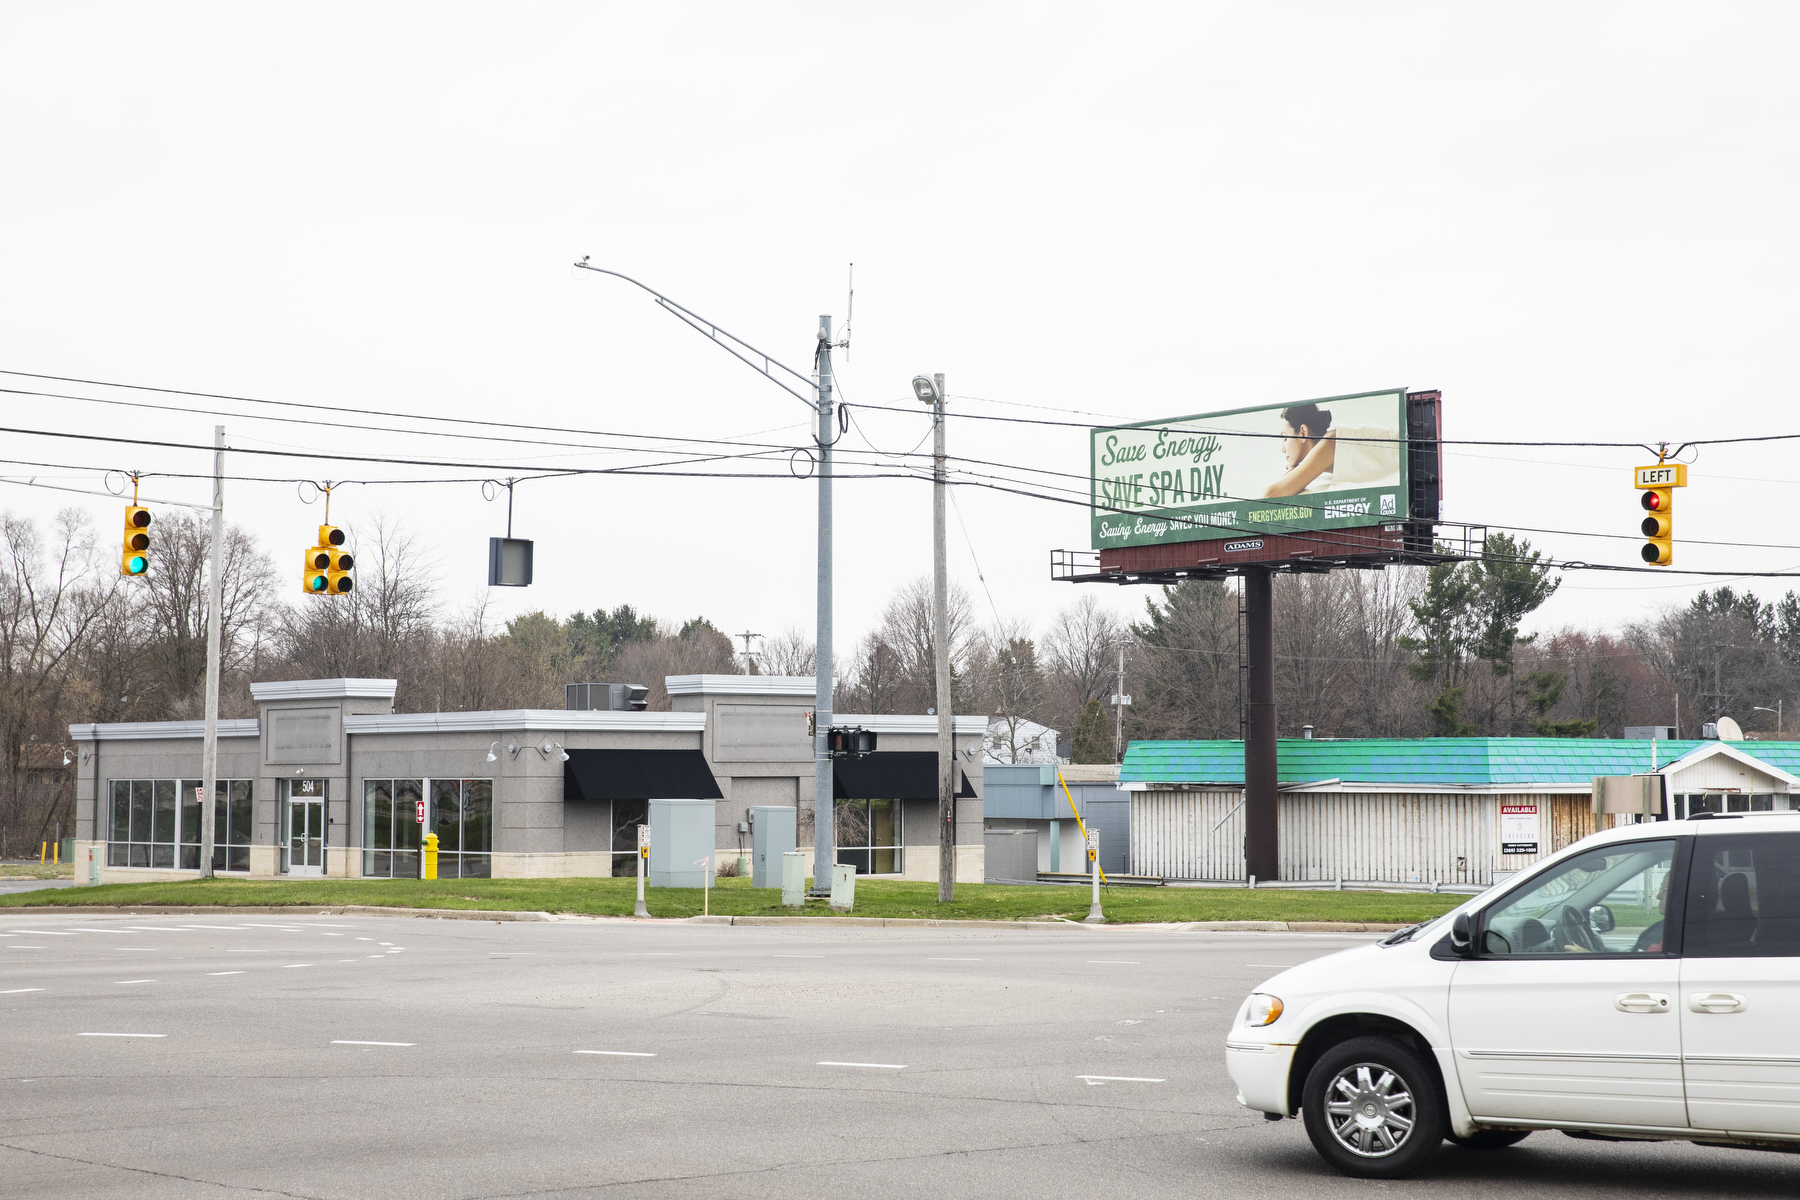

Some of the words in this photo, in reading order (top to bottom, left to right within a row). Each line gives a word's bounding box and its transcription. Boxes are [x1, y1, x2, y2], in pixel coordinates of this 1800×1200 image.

[1101, 435, 1146, 466] Save
[1152, 427, 1222, 463] Energy.
[1642, 469, 1671, 483] LEFT
[1101, 473, 1143, 511] SAVE
[1149, 469, 1185, 506] SPA
[1190, 464, 1227, 502] DAY.
[1324, 502, 1371, 519] ENERGY
[1381, 498, 1394, 510] Ad
[1248, 506, 1313, 523] ENERGYSAVERS.GOV
[1100, 521, 1131, 540] Saving
[1134, 518, 1167, 537] Energy
[1170, 515, 1192, 531] SAVES
[1193, 514, 1209, 529] YOU
[1210, 511, 1239, 526] MONEY.
[1228, 541, 1261, 550] ADAMS
[302, 780, 314, 792] 504
